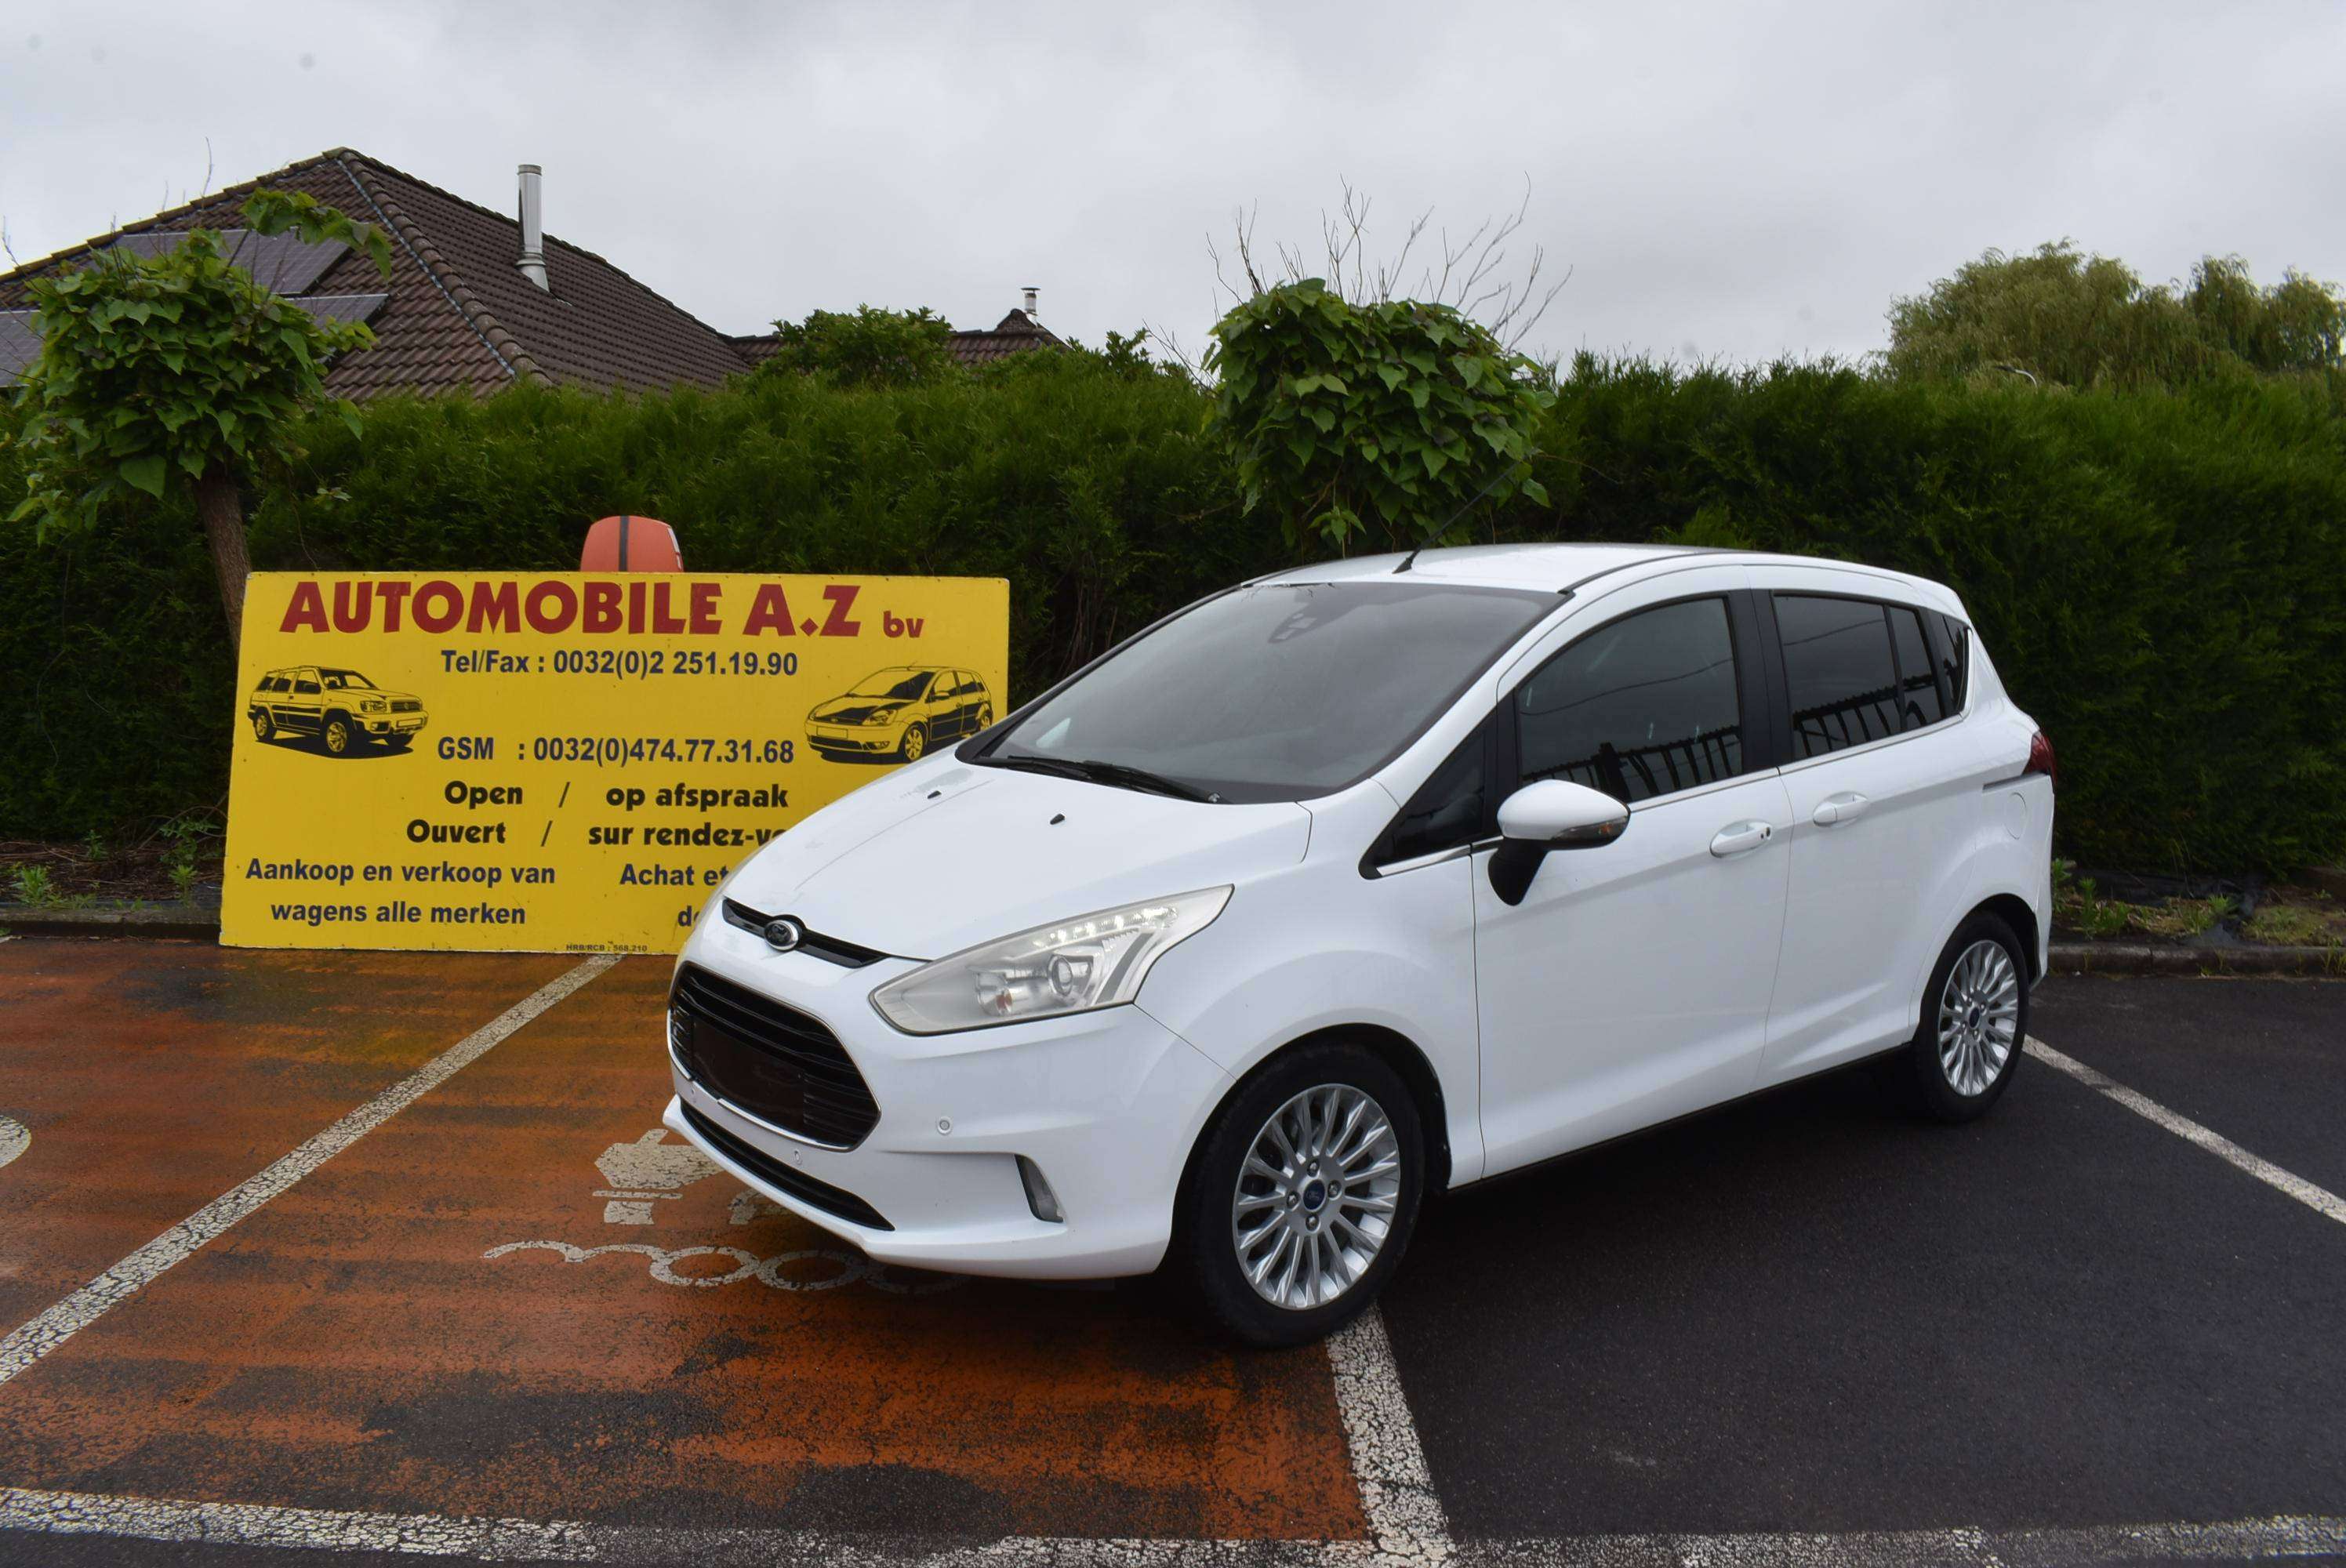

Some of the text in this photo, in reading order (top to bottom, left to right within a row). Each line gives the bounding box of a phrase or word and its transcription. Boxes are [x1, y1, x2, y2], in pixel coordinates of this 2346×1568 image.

[279, 580, 924, 638] AUTOMOBILE A.Z bv
[441, 649, 529, 673] Tel/Fax
[554, 650, 664, 681] 0032(0)2
[673, 651, 797, 676] 251.19.90
[438, 736, 494, 760] GSM
[533, 737, 794, 768] 0032(0)474.77.31.68
[444, 780, 789, 813] Open / op afspraak
[406, 818, 507, 844] Ouvert
[540, 820, 553, 847] /
[588, 826, 634, 846] sur
[245, 858, 555, 888] Aankoop en verkoop van
[619, 863, 695, 886] Achat
[271, 901, 525, 927] wagens alle merken
